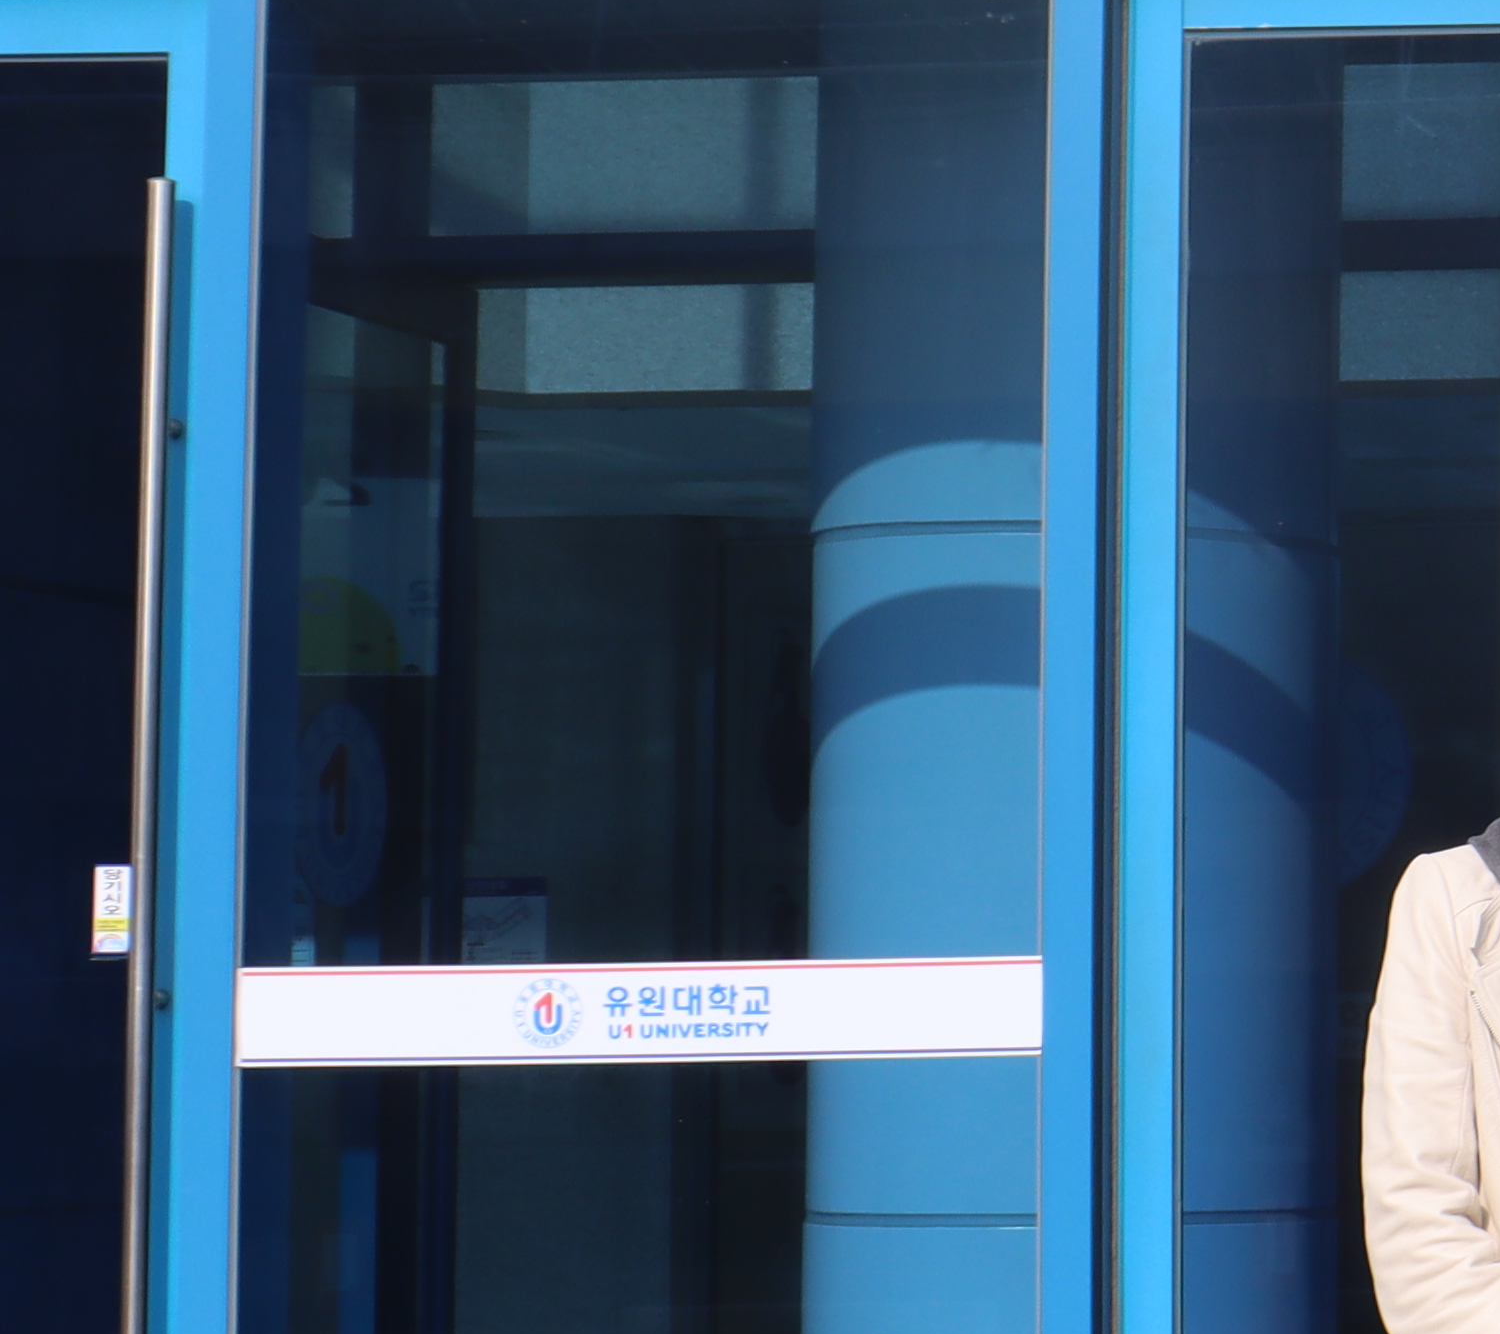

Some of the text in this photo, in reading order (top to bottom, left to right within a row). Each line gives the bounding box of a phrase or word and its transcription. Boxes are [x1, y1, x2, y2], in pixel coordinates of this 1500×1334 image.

[603, 983, 771, 1017] 유원대학교
[608, 1021, 770, 1040] U1 UNIVERSITY
